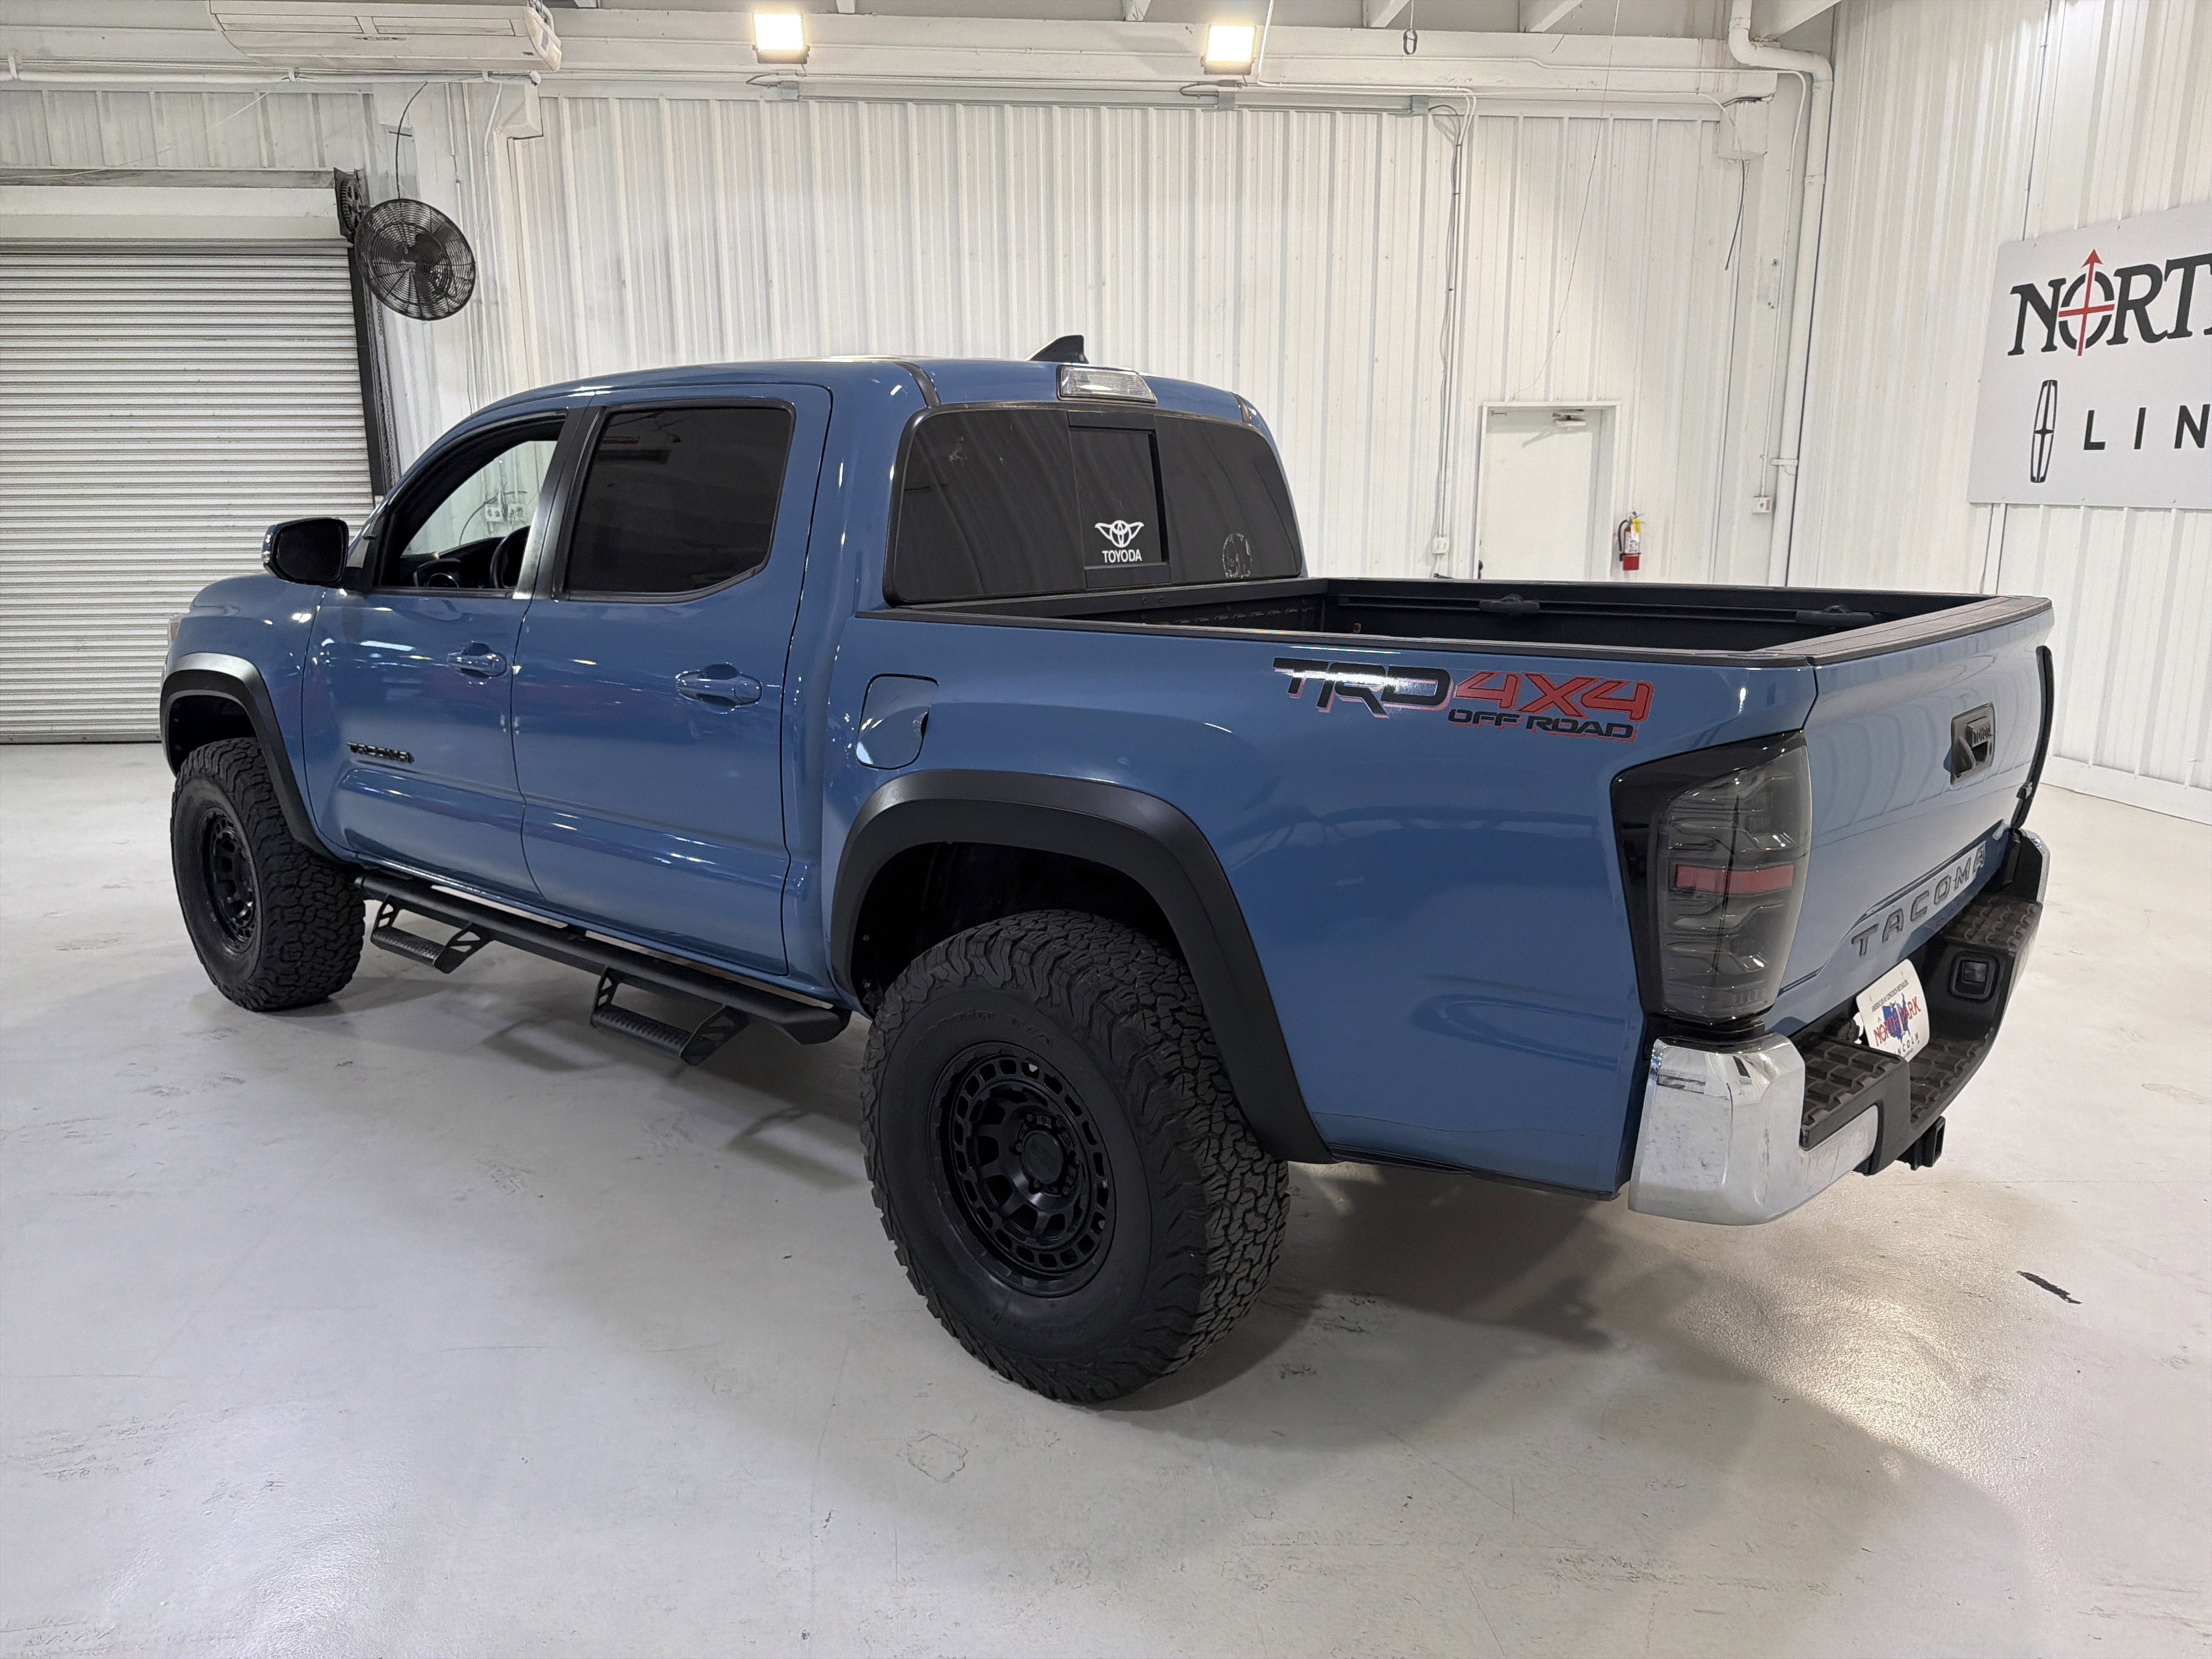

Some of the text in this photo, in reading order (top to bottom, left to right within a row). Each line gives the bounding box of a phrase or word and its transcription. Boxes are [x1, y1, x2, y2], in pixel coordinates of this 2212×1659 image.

[2007, 253, 2212, 357] NORT
[2083, 403, 2211, 451] LIN
[1102, 549, 1142, 563] TOYODA
[1272, 657, 1454, 719] TRD
[1447, 708, 1638, 743] OFF ROAD
[1850, 840, 1987, 957] TACOMA
